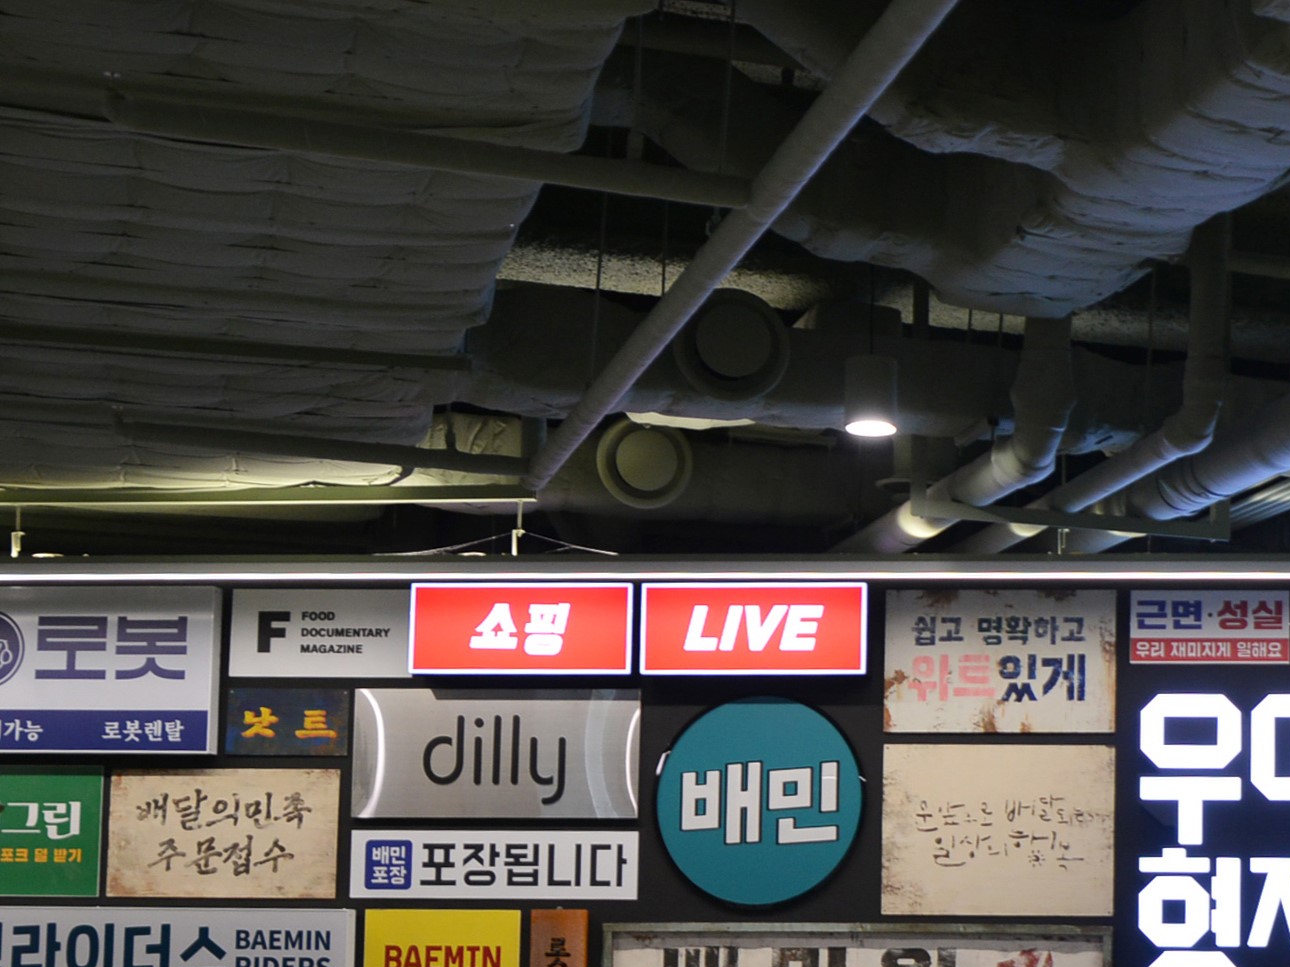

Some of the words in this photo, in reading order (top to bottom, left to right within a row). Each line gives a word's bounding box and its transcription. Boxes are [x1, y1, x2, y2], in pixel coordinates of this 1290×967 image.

[257, 611, 291, 653] F
[301, 611, 336, 622] FOOD
[301, 627, 391, 638] DOCUMENTARY
[469, 603, 571, 656] 쇼핑
[683, 604, 824, 652] LIVE
[912, 616, 964, 646] 쉽고
[977, 616, 1087, 646] 명확하고
[35, 615, 188, 680] 로봇
[300, 643, 364, 654] MAGAZINE
[1136, 642, 1165, 658] 우리
[1170, 640, 1231, 658] 재미지게
[1237, 640, 1283, 658] 일해요
[908, 653, 1087, 703] 위트있게
[0, 718, 43, 741] 가능
[101, 718, 185, 742] 로봇렌탈
[422, 714, 566, 805] dilly
[135, 789, 313, 830] 배달의민족
[680, 759, 840, 845] 배민
[147, 834, 295, 876] 주문접수
[372, 846, 407, 865] 배민
[419, 843, 628, 887] 포장됩니다
[371, 866, 407, 886] 포장
[235, 929, 331, 950] BAEMIN
